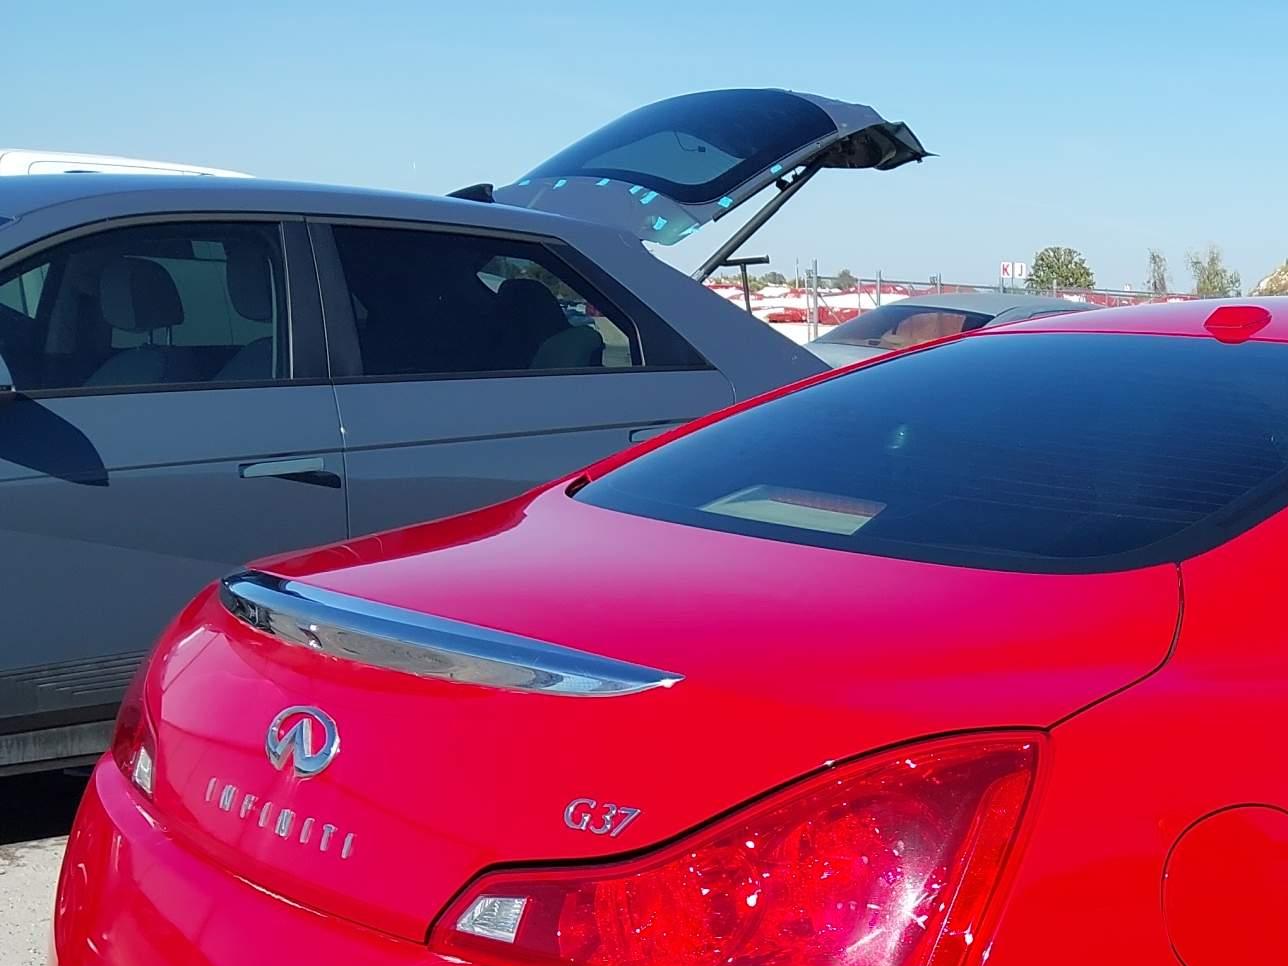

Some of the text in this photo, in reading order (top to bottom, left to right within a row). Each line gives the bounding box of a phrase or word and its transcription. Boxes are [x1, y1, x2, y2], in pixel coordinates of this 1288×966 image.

[1002, 263, 1010, 277] K
[204, 777, 358, 860] INFINITI
[563, 797, 641, 838] G37
